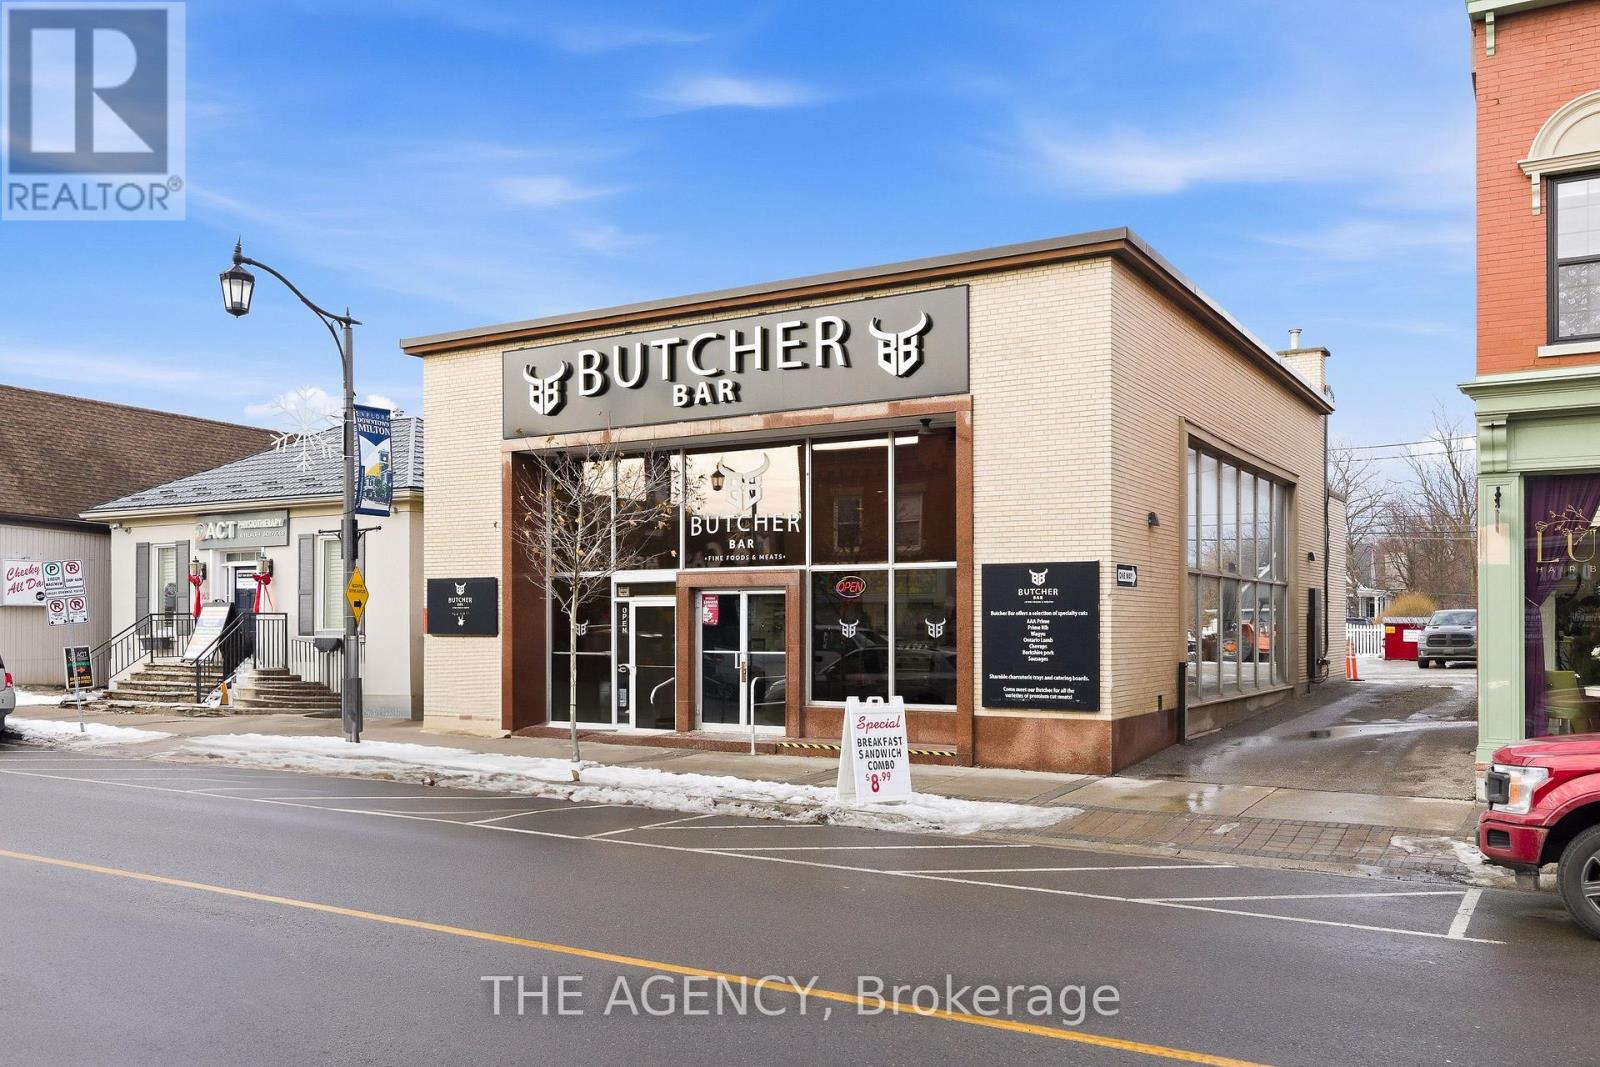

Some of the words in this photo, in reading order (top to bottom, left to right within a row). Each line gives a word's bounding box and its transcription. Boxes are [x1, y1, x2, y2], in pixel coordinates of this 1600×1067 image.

[578, 316, 849, 397] BUTCHER
[673, 379, 735, 407] BAR
[358, 423, 390, 436] MILTON
[205, 521, 236, 539] ACT
[690, 513, 800, 536] BUTCHER
[729, 539, 754, 549] BAR
[6, 564, 41, 581] Cheeky
[7, 581, 24, 596] All
[26, 578, 43, 590] Da
[837, 581, 864, 592] OPEN
[1018, 588, 1058, 596] BUTCHER
[857, 715, 900, 734] Special
[857, 736, 902, 747] BREAKFAST
[858, 748, 902, 759] SANDWICH
[867, 760, 895, 770] COMBO
